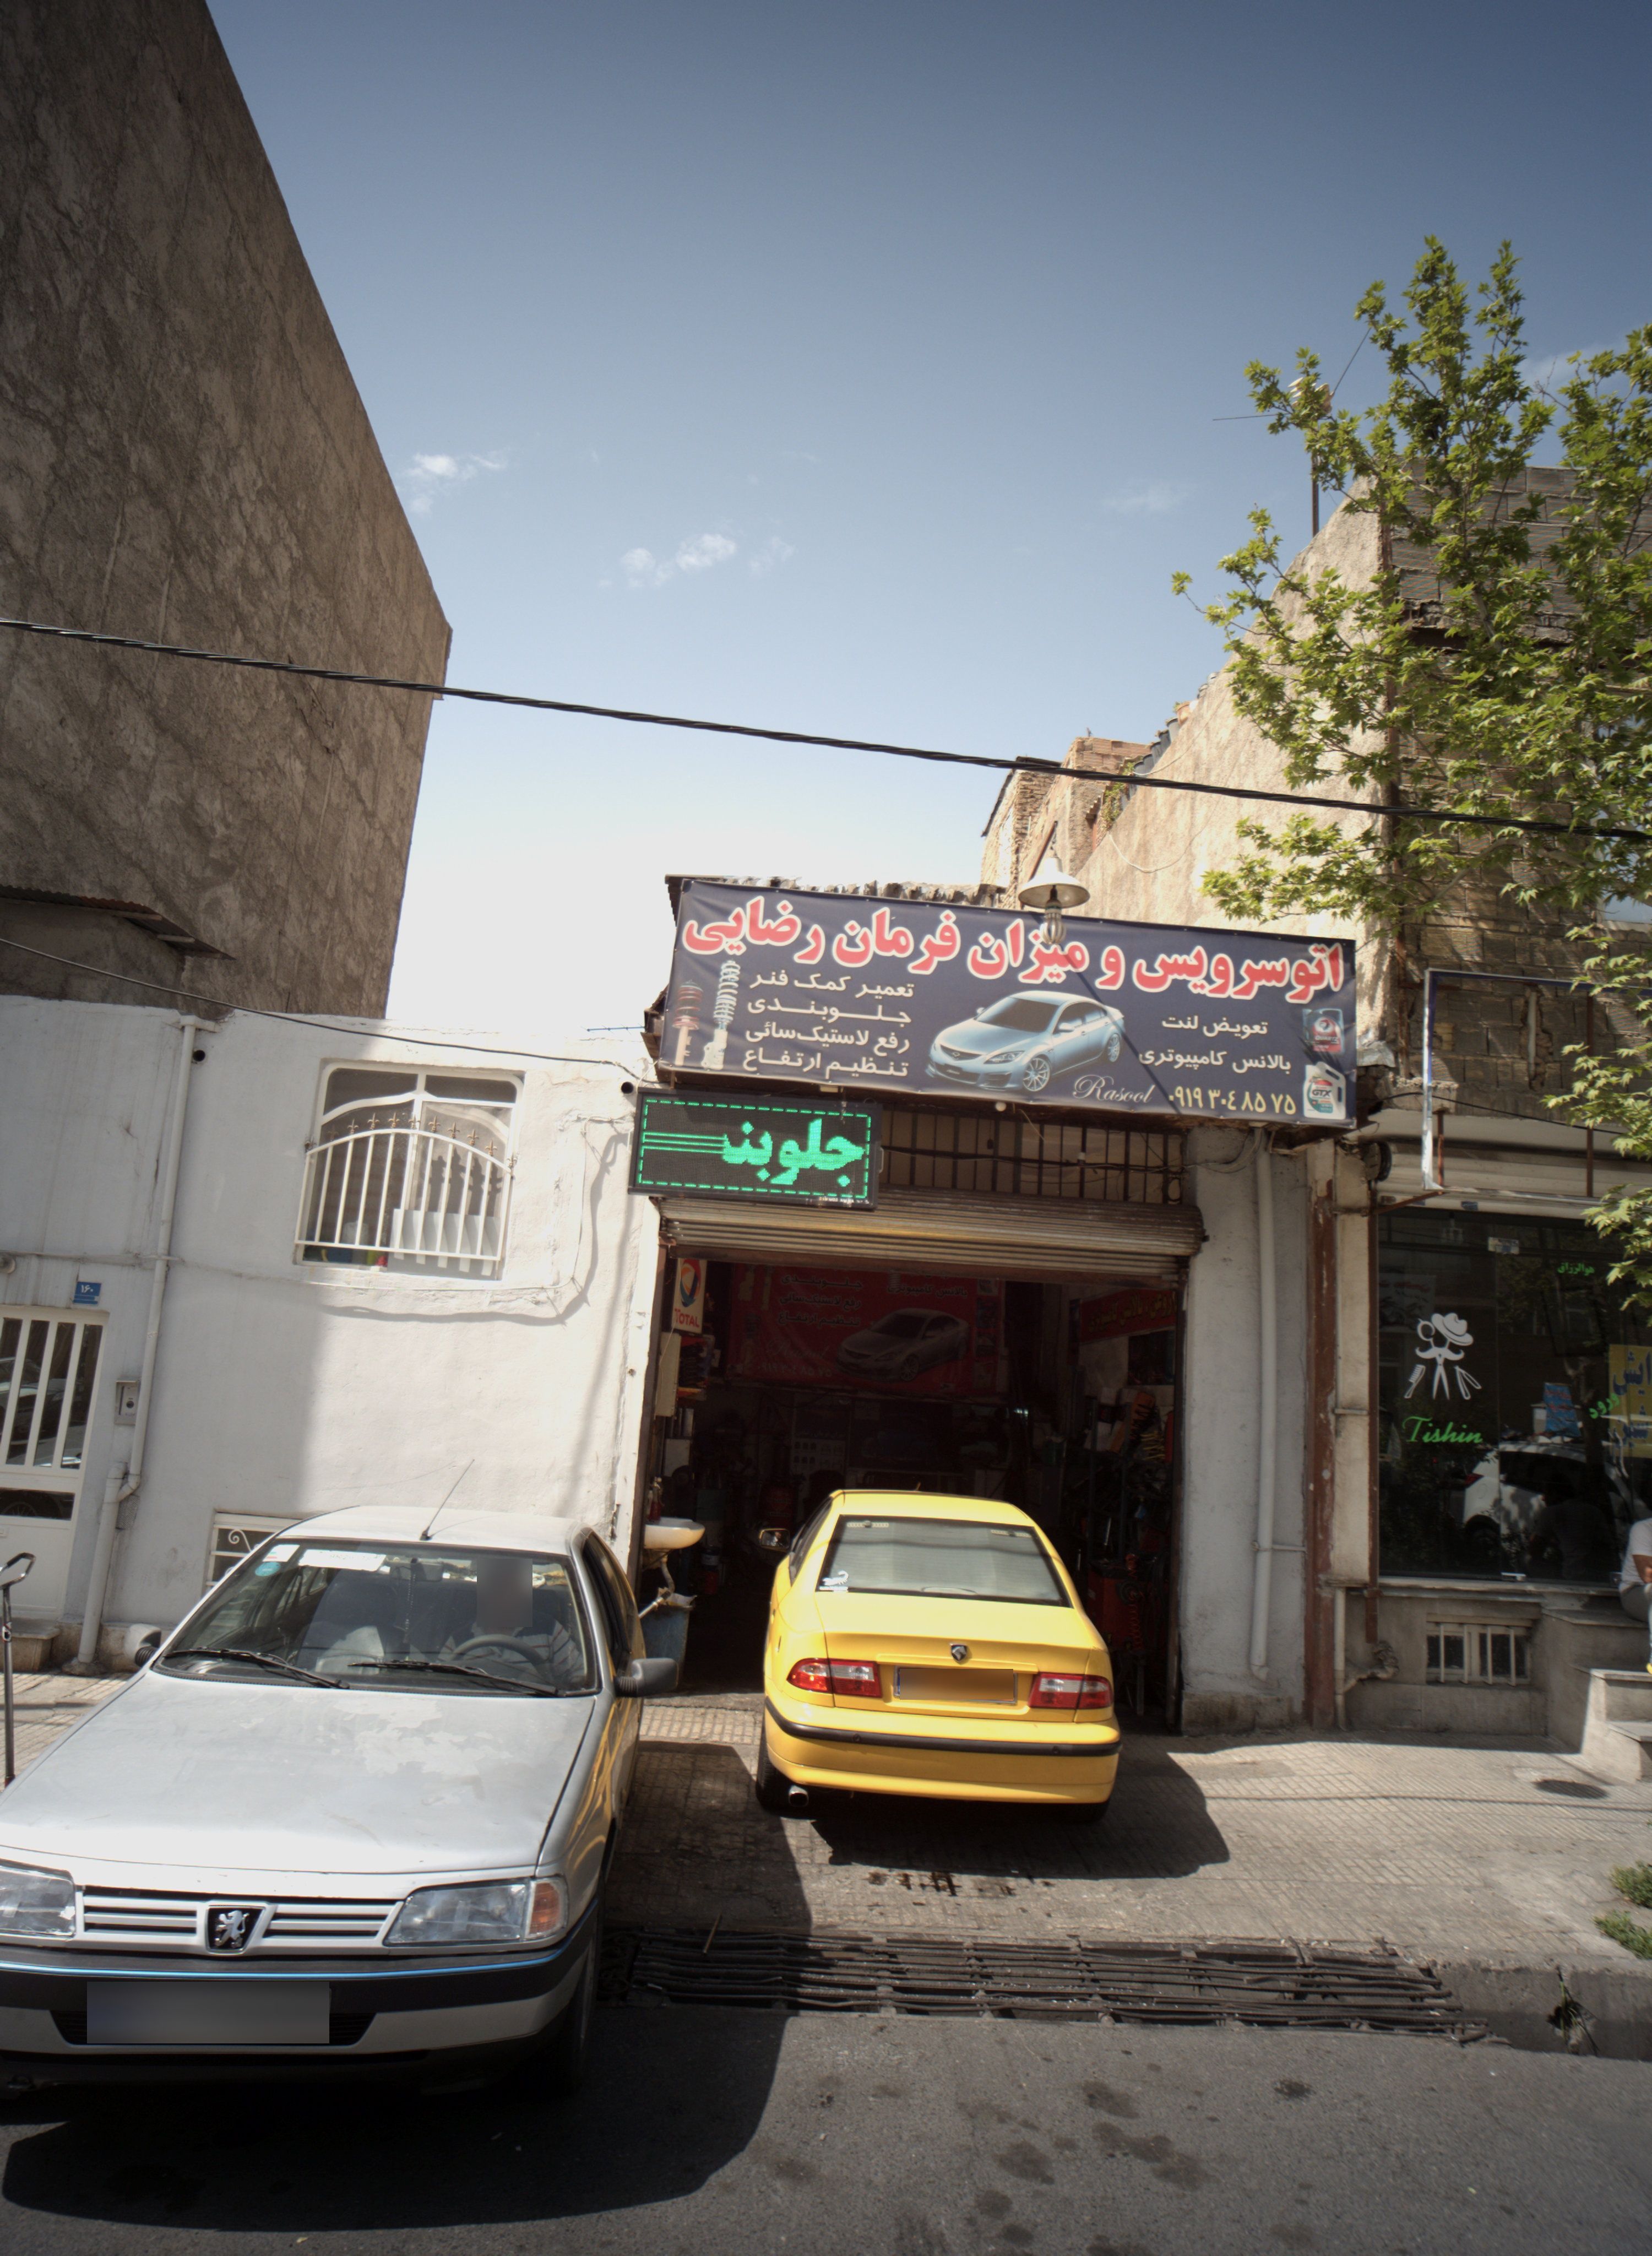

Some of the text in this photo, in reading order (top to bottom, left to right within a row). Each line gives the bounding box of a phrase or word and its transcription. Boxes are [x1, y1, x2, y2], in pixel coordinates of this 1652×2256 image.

[682, 896, 826, 965] رضایی
[832, 907, 961, 975] فرمان
[967, 918, 1090, 984] میزان
[1095, 945, 1126, 990] و
[749, 969, 915, 999] تعمیر کمک فنر
[747, 998, 912, 1024] جلوبندی
[1161, 1015, 1268, 1040] تعویض لنت
[873, 1032, 910, 1057] رفع
[742, 1047, 909, 1080] تنظیم ارتفاع
[1138, 1049, 1291, 1075] بالانس کامپیوتری
[1073, 1074, 1155, 1103] Rasool
[81, 1284, 94, 1293] ۱۶۰
[674, 1308, 700, 1328] TOTAL
[1402, 1416, 1482, 1444] Tishin
